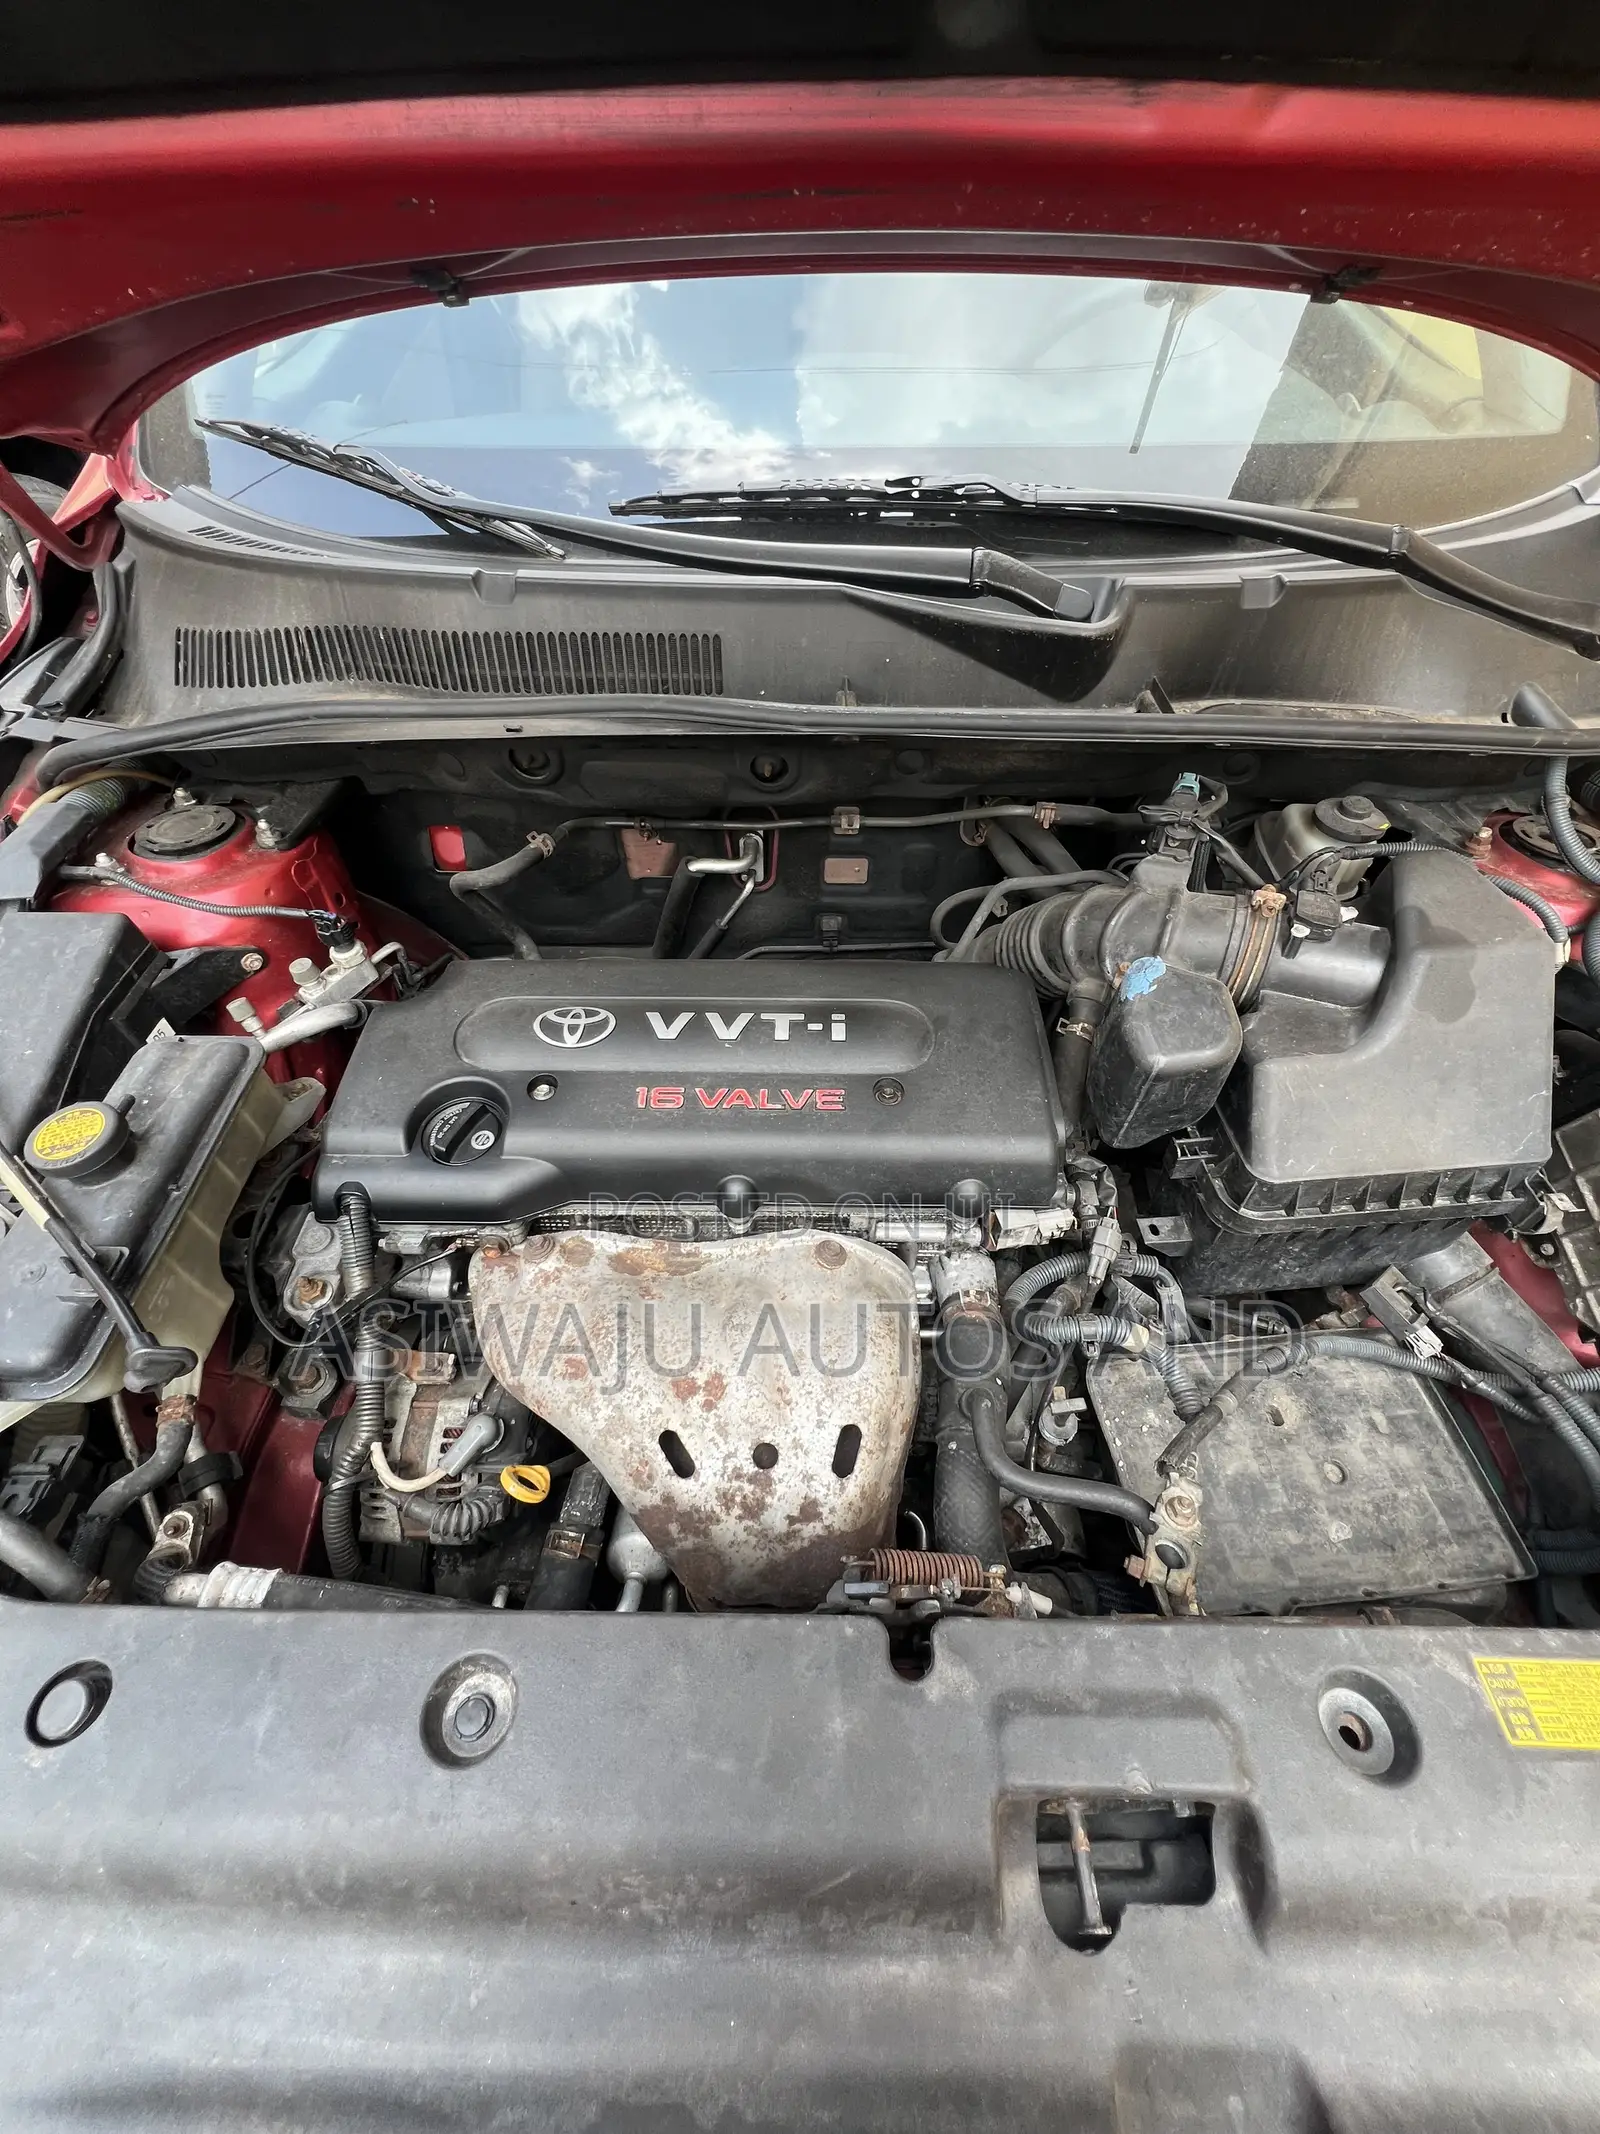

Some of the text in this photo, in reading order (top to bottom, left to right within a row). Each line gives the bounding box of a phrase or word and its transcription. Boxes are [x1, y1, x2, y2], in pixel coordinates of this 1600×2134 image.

[645, 1011, 848, 1042] VVT-i
[636, 1086, 847, 1112] 16 VALVE
